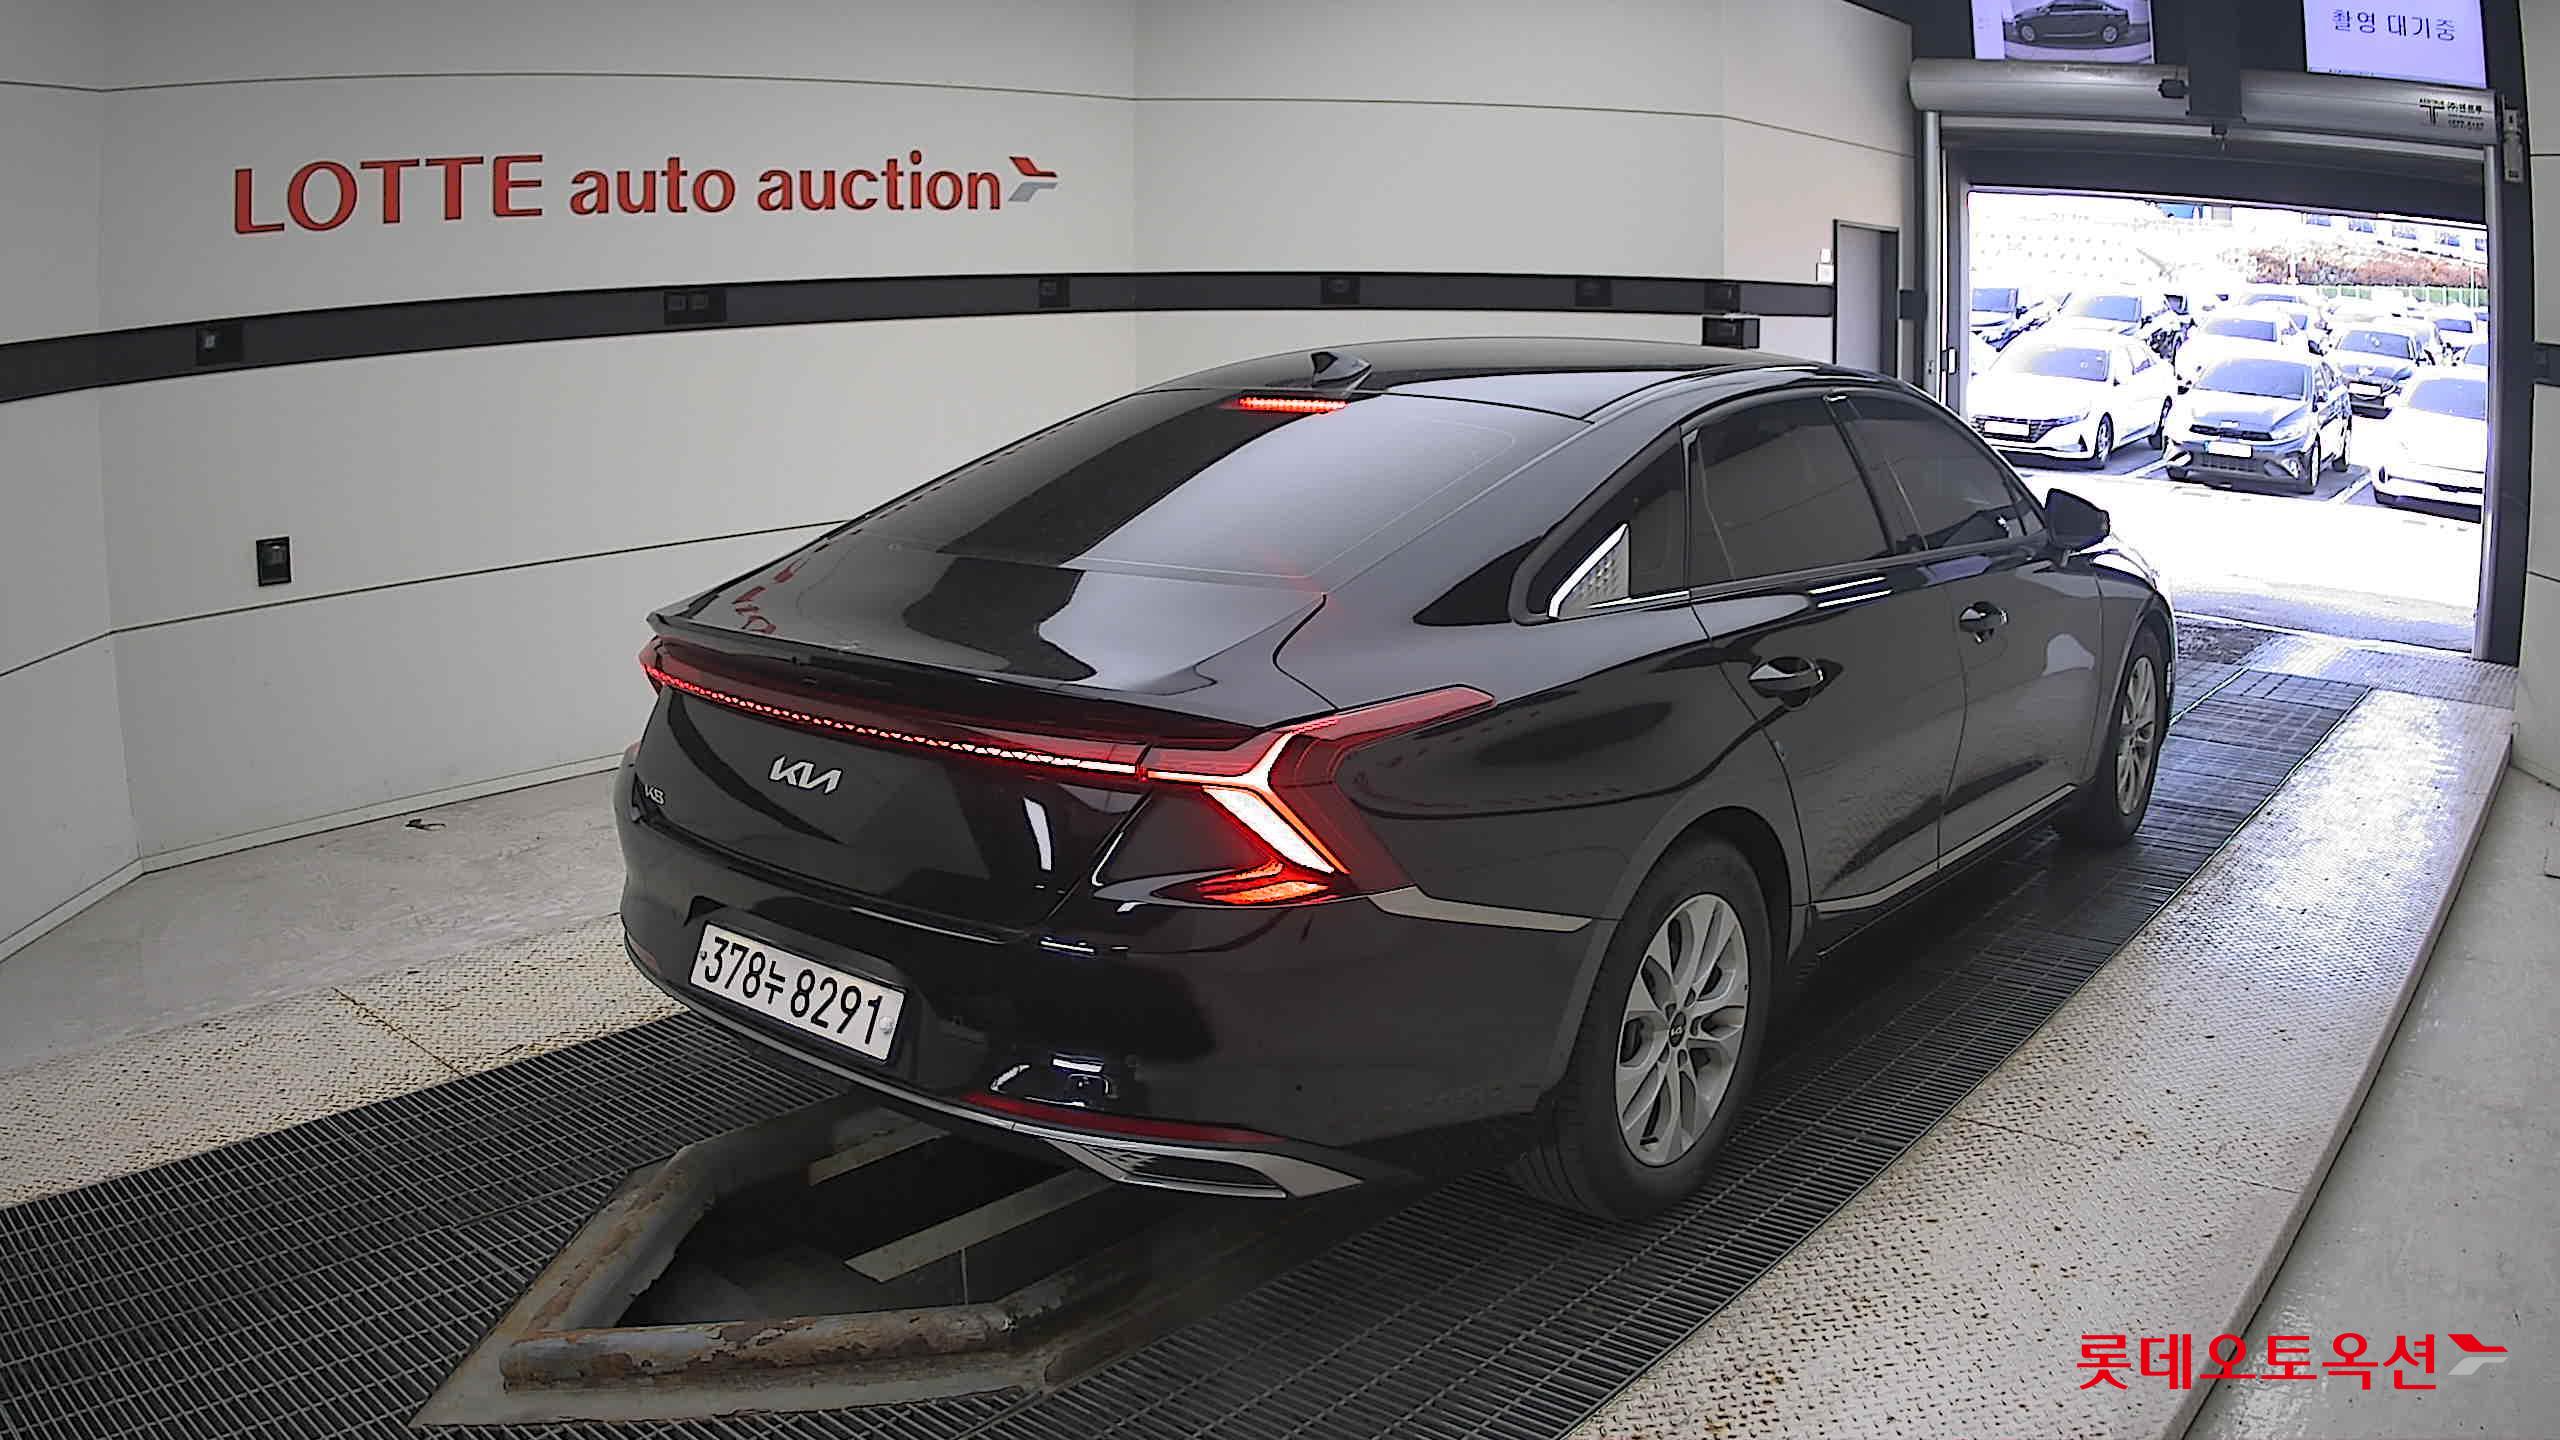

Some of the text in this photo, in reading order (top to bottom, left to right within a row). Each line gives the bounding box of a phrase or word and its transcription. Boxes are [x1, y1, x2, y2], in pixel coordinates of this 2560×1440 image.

[2332, 9, 2456, 42] 촬영 대기중
[234, 149, 1001, 235] LOTTE auto auction
[769, 754, 844, 795] KIA
[644, 783, 666, 806] K8
